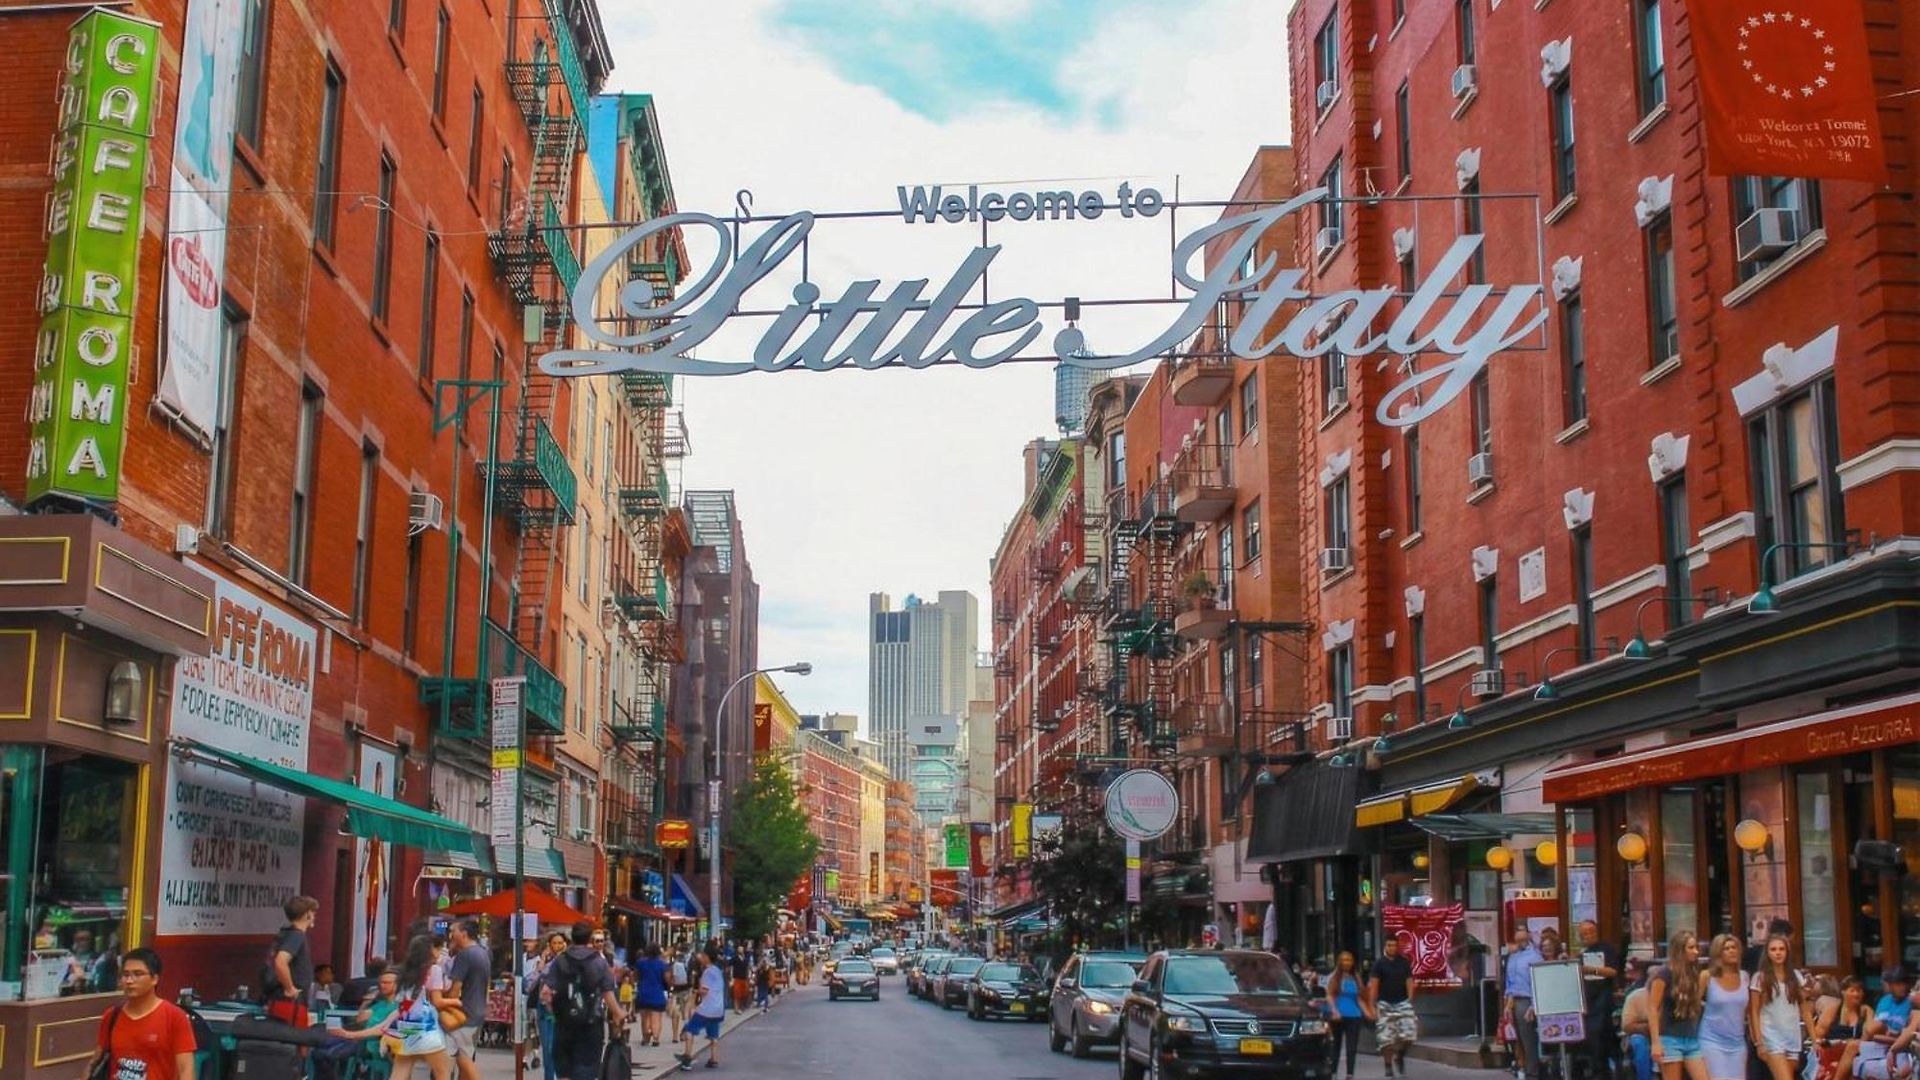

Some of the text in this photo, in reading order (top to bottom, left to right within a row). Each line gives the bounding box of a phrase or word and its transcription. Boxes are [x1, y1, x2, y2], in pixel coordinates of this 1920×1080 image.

[66, 33, 146, 479] CAFE ROMA
[897, 181, 1162, 224] Welcome to
[538, 187, 1550, 428] Little Italy
[258, 619, 311, 693] ROMA
